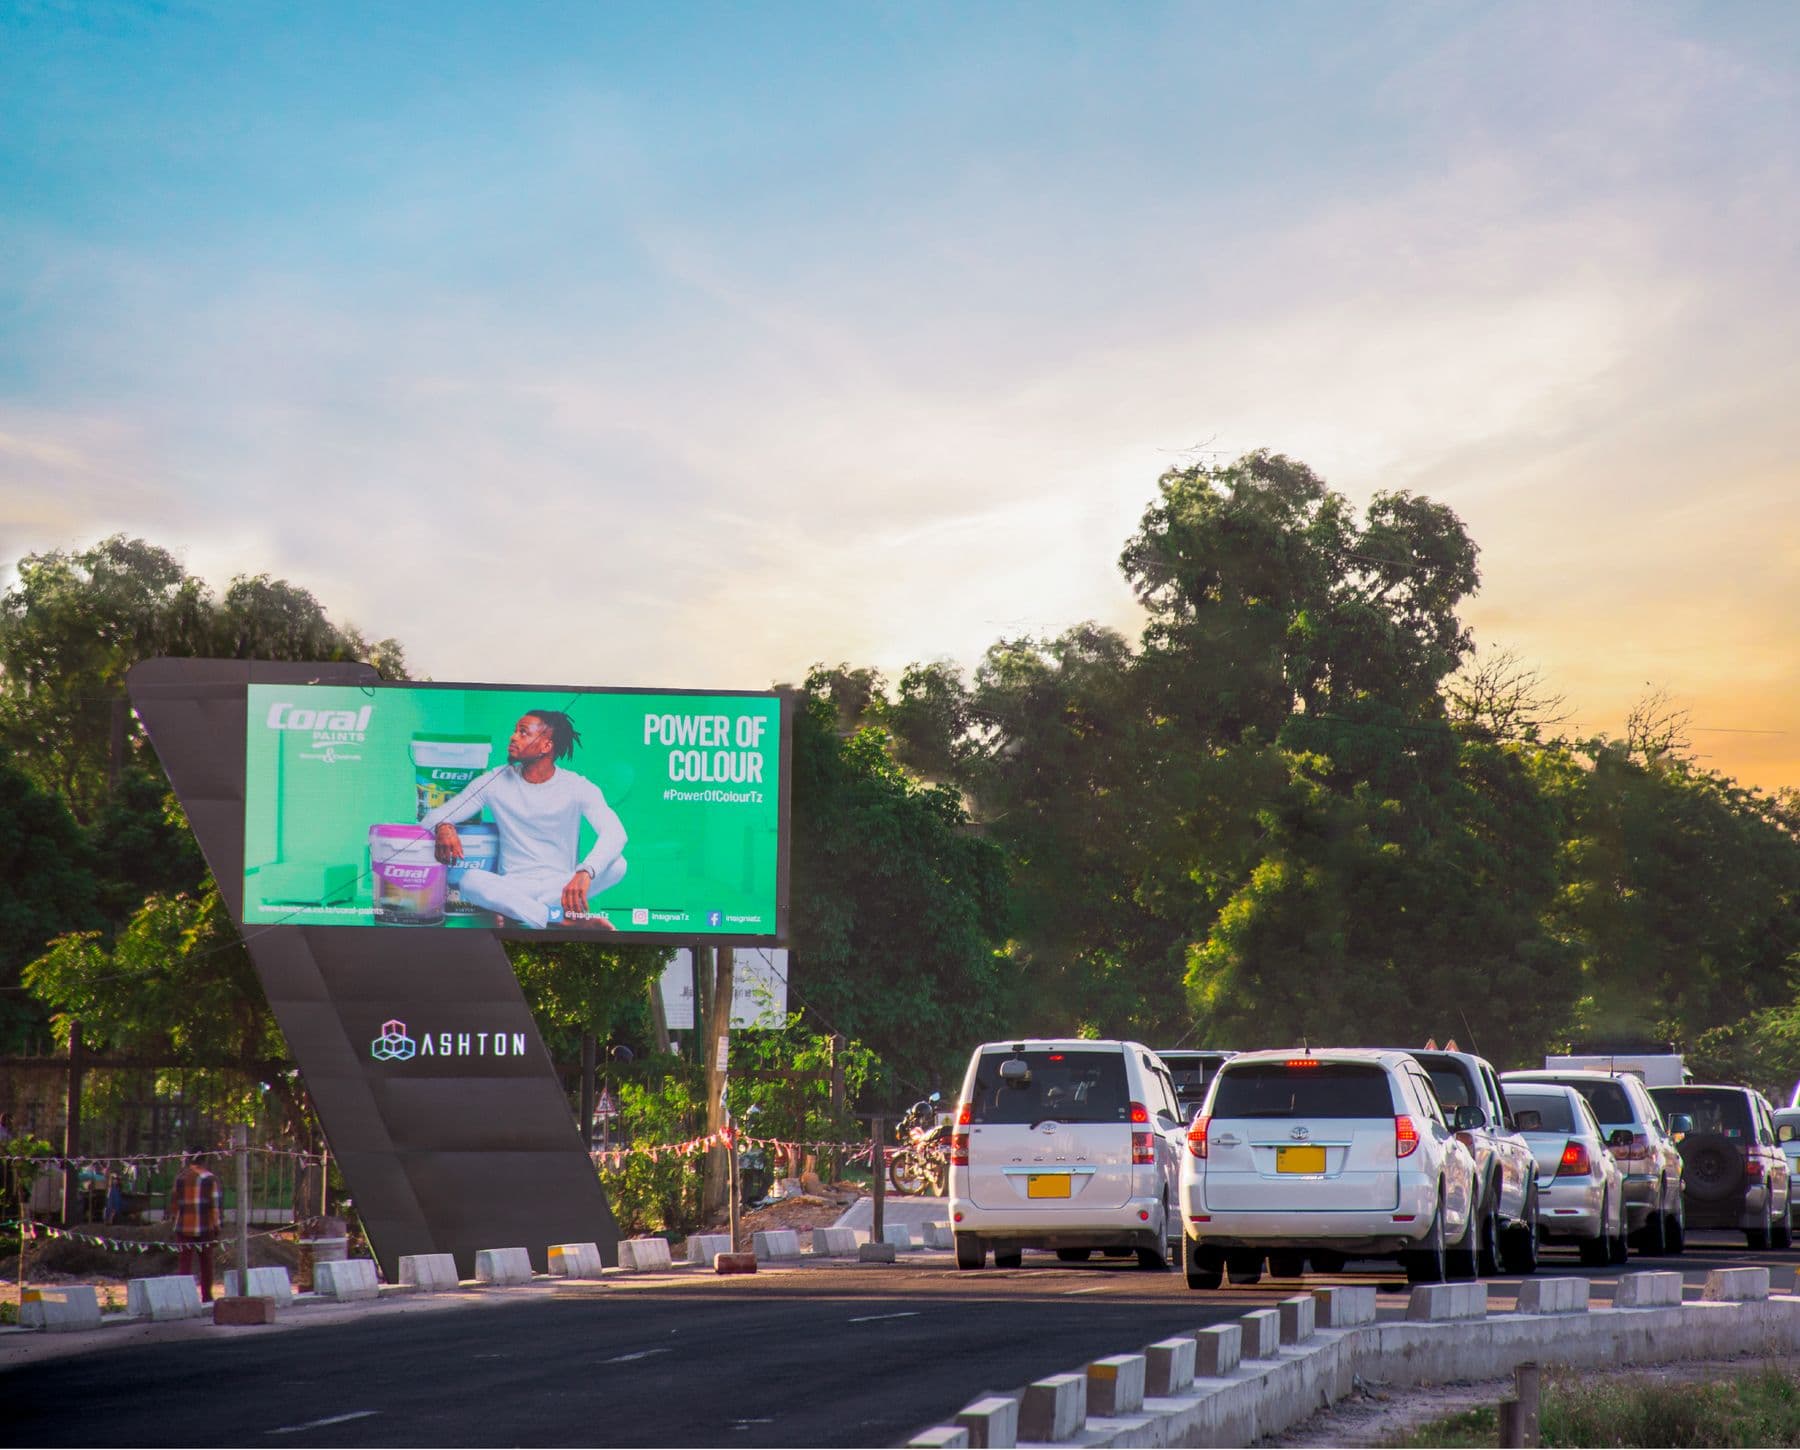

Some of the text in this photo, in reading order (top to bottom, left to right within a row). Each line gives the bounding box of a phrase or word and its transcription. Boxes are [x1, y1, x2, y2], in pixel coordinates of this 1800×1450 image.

[267, 703, 372, 731] Coral
[312, 731, 365, 742] PAINTS
[644, 713, 767, 748] POWER OF
[668, 750, 763, 783] COLOUR
[431, 768, 474, 780] Coral
[663, 789, 763, 803] #PowerOfColourTz
[448, 858, 486, 869] oral
[383, 865, 431, 878] Coral
[421, 1032, 525, 1056] ASHTON
